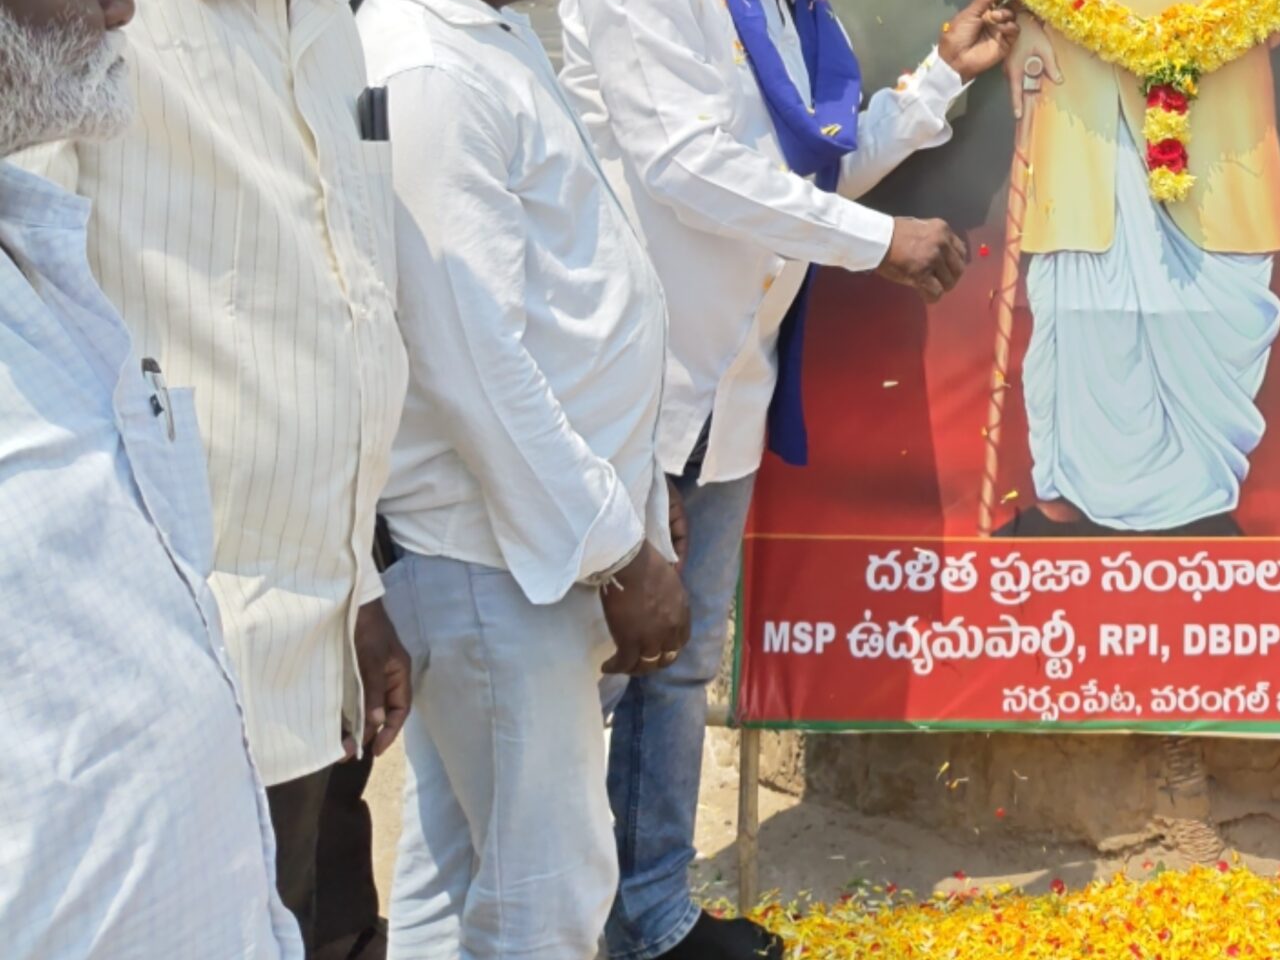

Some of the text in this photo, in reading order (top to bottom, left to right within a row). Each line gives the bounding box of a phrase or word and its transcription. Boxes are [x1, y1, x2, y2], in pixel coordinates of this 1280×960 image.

[865, 546, 979, 594] దళిత
[989, 551, 1092, 606] ప్రజా
[763, 621, 836, 654] MSP
[1098, 623, 1170, 664] RPI,
[1150, 680, 1271, 714] వరంగల్
